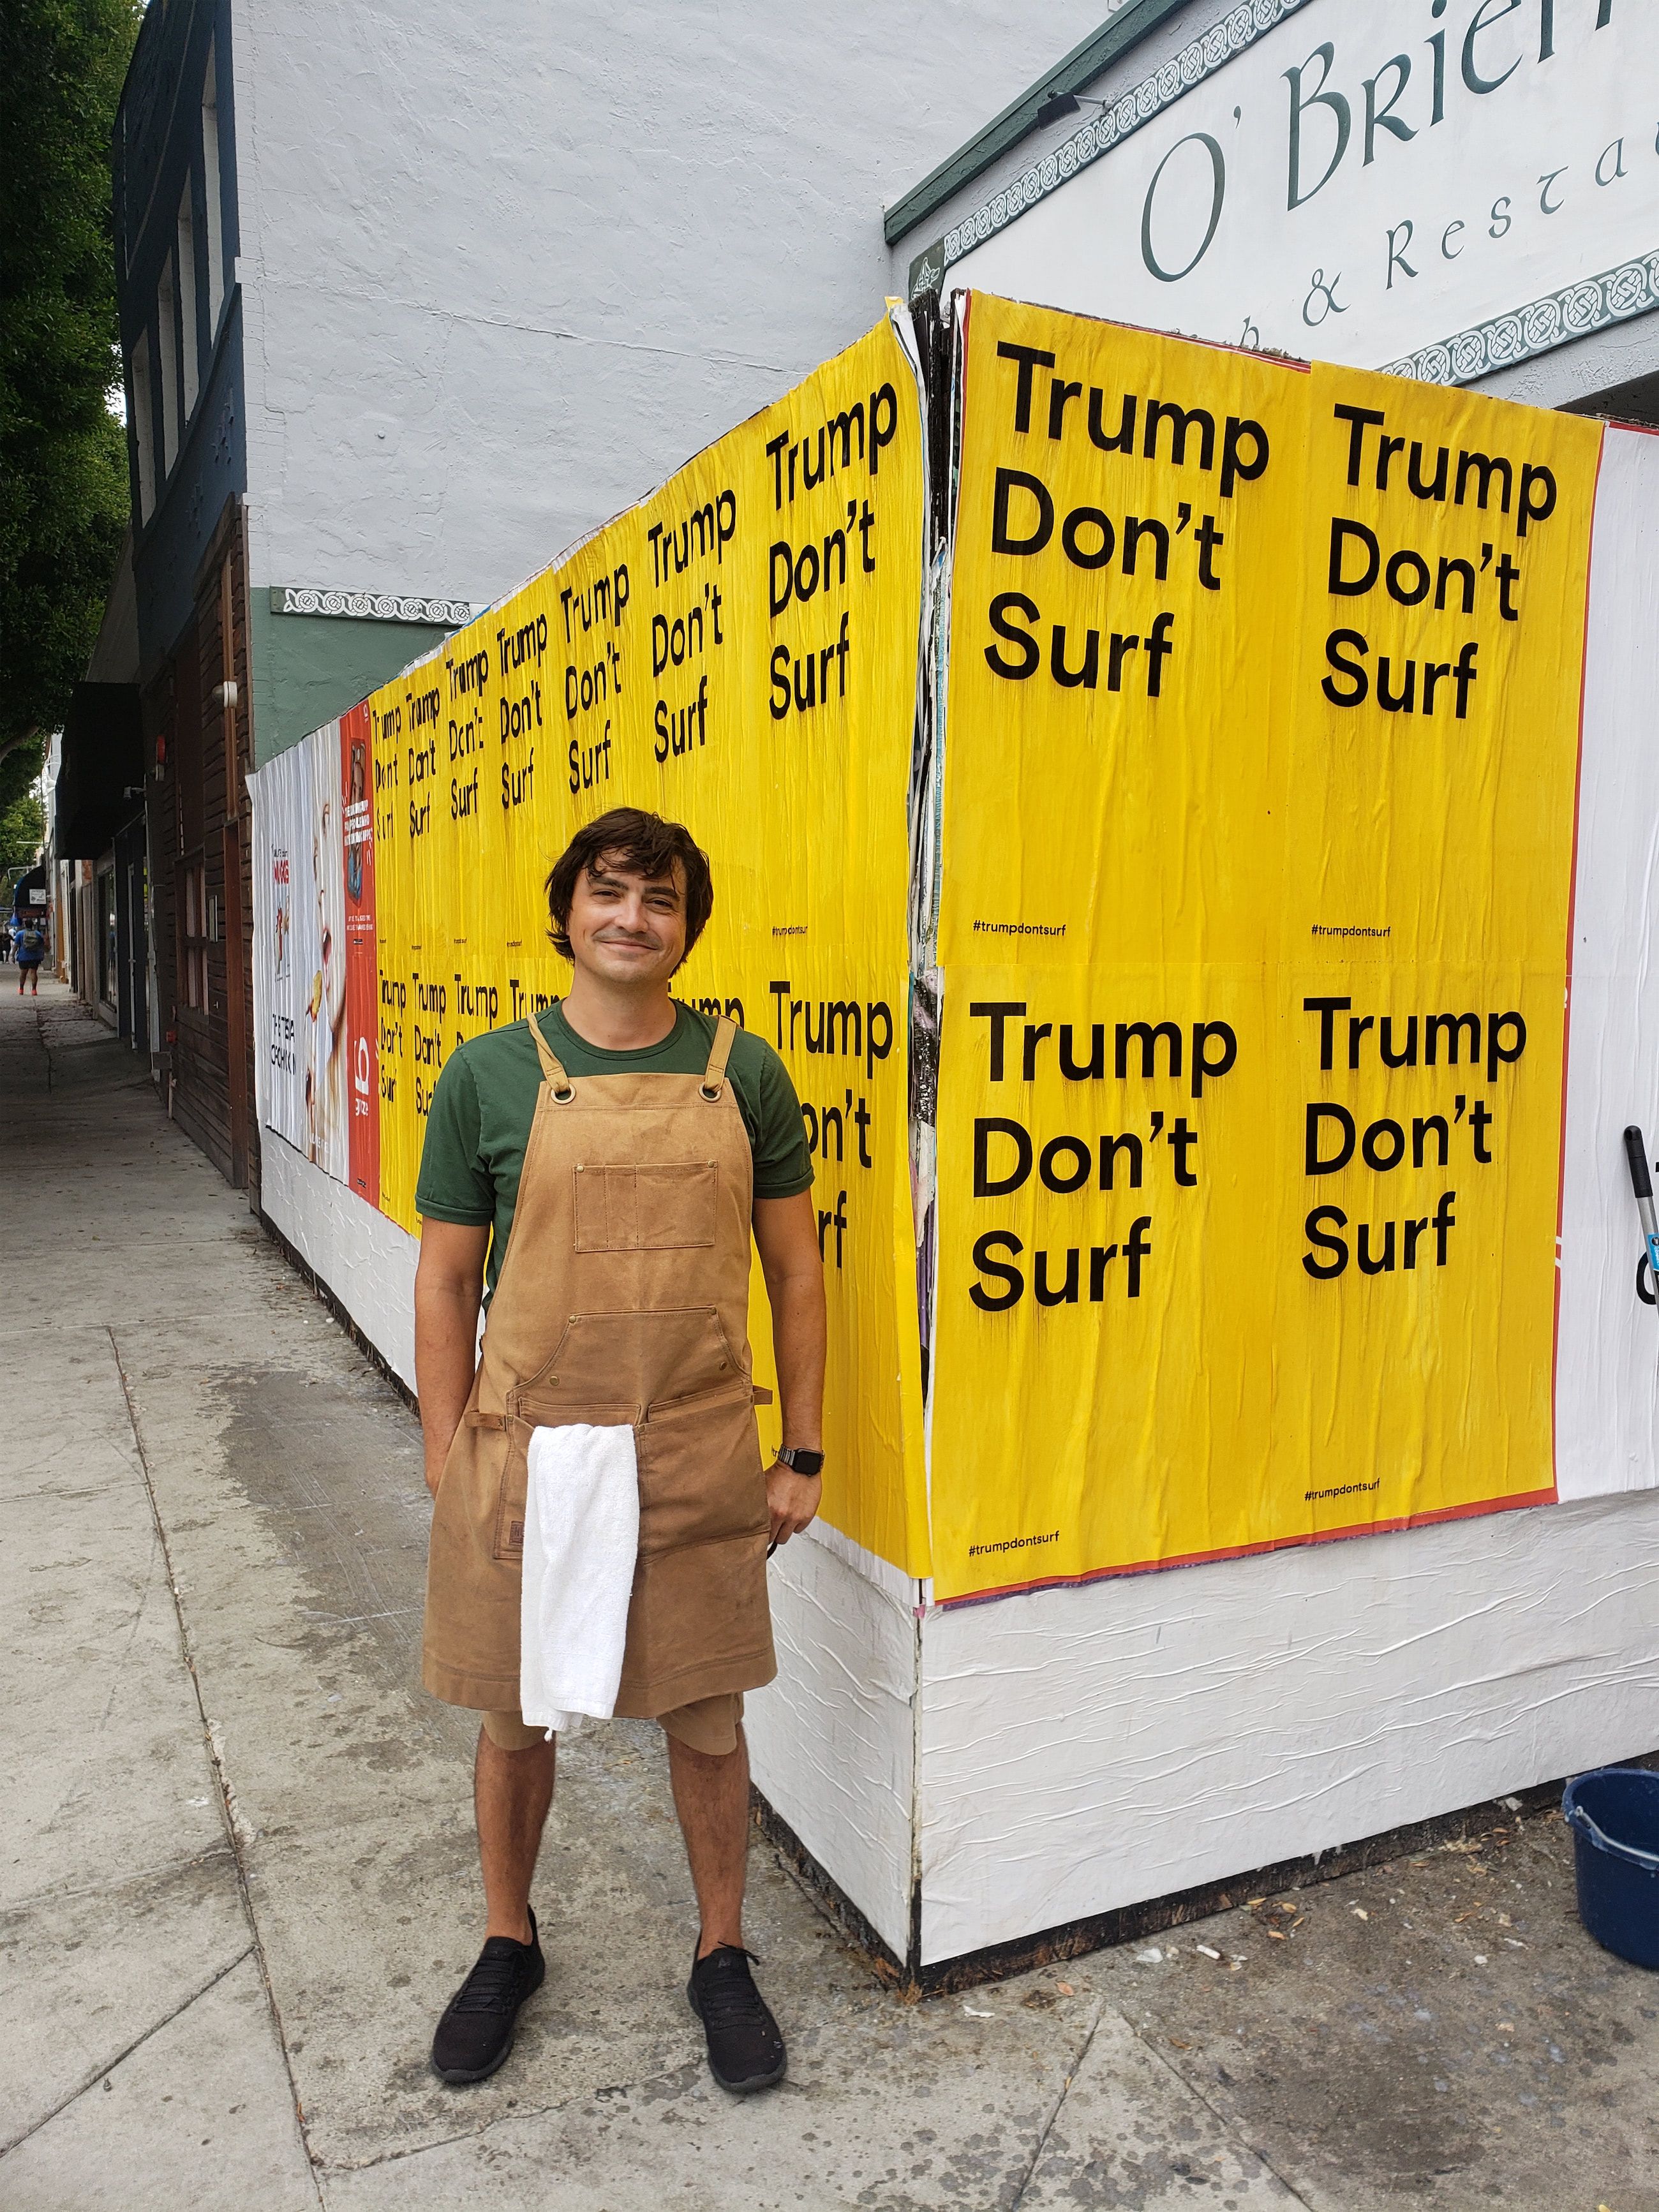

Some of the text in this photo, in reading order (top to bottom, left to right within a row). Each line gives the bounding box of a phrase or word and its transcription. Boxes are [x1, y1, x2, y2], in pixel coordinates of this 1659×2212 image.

[1302, 121, 1659, 326] & Resta
[766, 383, 897, 510] Trump
[997, 341, 1269, 498] Trump
[1334, 403, 1557, 537] Trump
[648, 489, 736, 588] Trump
[770, 499, 875, 618] Don't
[992, 466, 1223, 590] Don't
[560, 563, 629, 643] Trump
[1328, 517, 1520, 621] Don't
[496, 614, 547, 676] Trump
[652, 582, 723, 678] Don't
[770, 611, 849, 720] Surf
[984, 592, 1175, 697] Surf
[406, 687, 440, 732] Trump
[445, 649, 489, 702] Trump
[500, 679, 542, 745] Don't
[565, 641, 621, 720] Don't
[1321, 628, 1478, 718] Surf
[372, 706, 401, 744] Trump
[449, 707, 484, 762] Don't
[569, 720, 611, 794] Surf
[653, 675, 708, 762] Surf
[408, 738, 436, 785] Don't
[451, 767, 478, 820] Surf
[502, 747, 534, 809] Surf
[410, 791, 430, 838] Surf
[973, 920, 1066, 936] #trumpdontsurf
[1311, 924, 1391, 938] #trumpdontsurf
[412, 972, 446, 1024] Trump
[454, 974, 498, 1030] Trump
[509, 979, 560, 1022] Trum
[770, 981, 893, 1080] Trump
[969, 1002, 1237, 1098] Trump
[1303, 997, 1527, 1083] Trump
[801, 1088, 872, 1168] on't
[973, 1111, 1198, 1198] Don't
[1305, 1094, 1492, 1176] Don't
[969, 1216, 1152, 1312] Surf
[1302, 1191, 1456, 1280] Surf
[1304, 1478, 1380, 1501] #trumpdontsurf
[969, 1531, 1059, 1557] #trumpdontsurf
